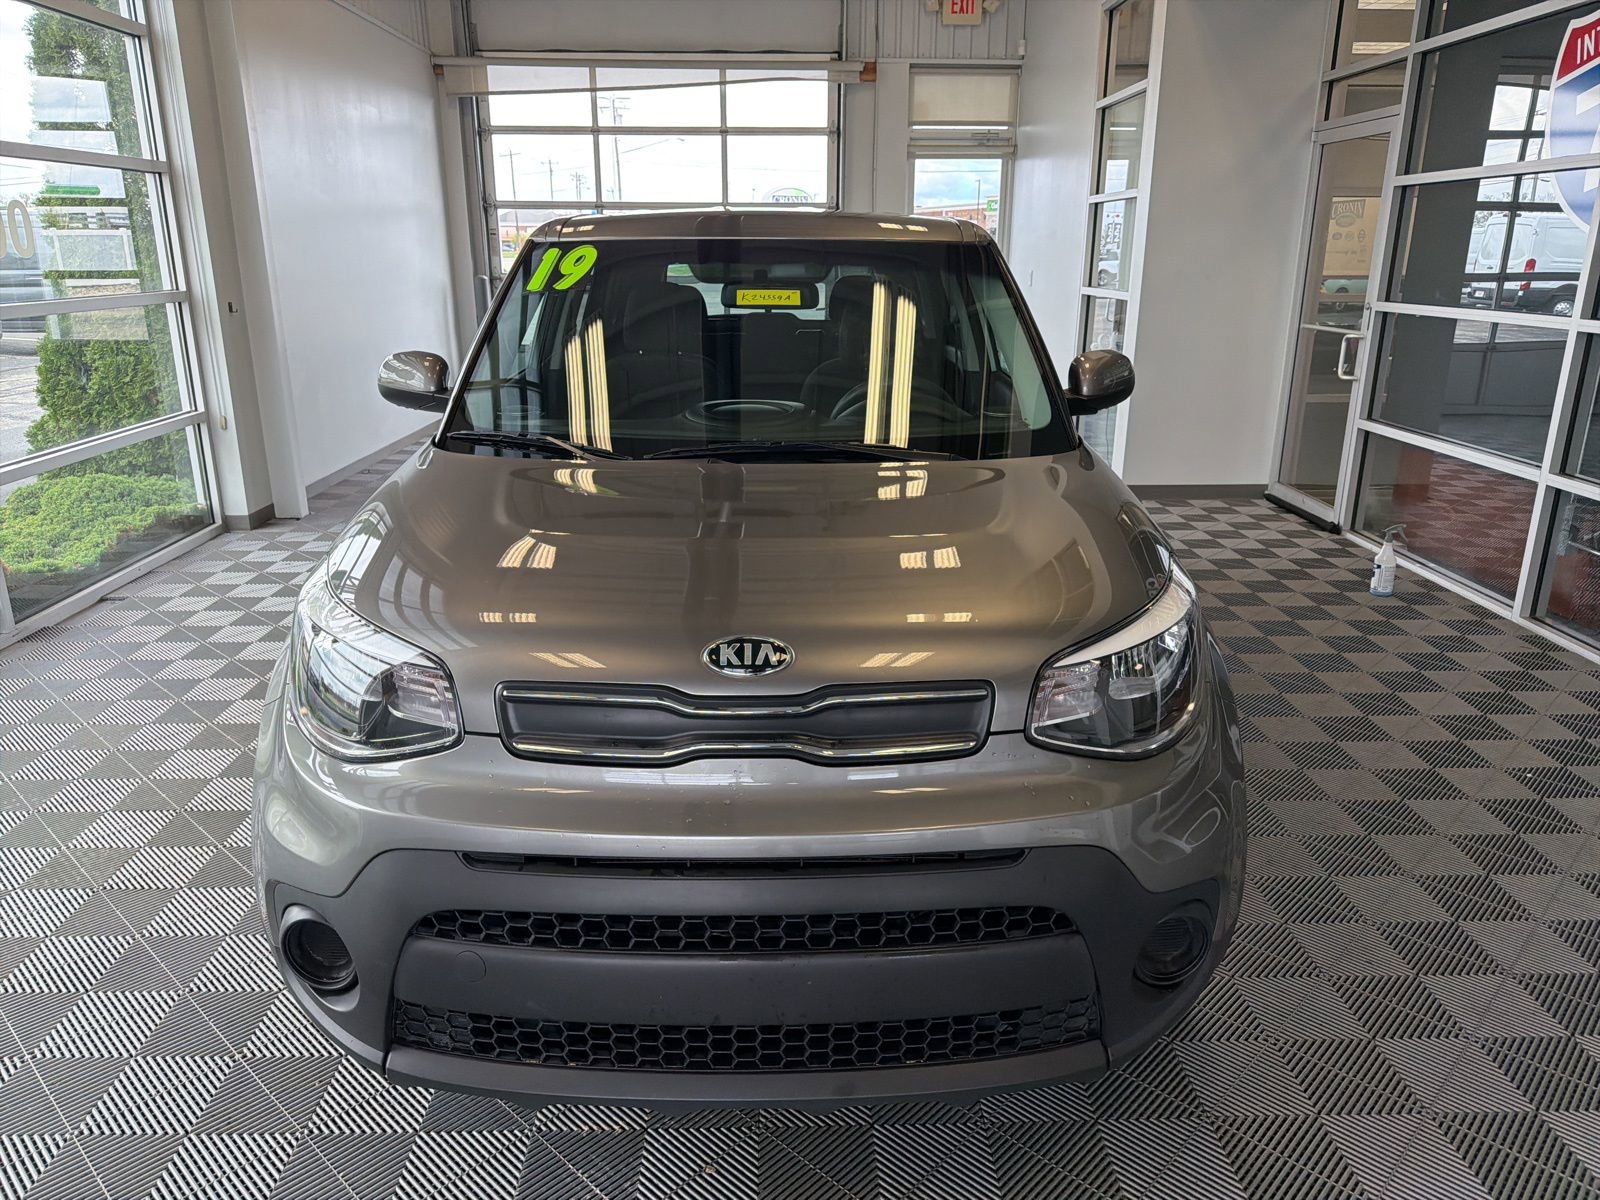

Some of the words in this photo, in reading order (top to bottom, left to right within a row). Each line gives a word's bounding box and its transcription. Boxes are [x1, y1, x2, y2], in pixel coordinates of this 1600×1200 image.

[951, 0, 975, 15] EXIT
[526, 244, 598, 292] 19
[719, 643, 778, 666] KIA
